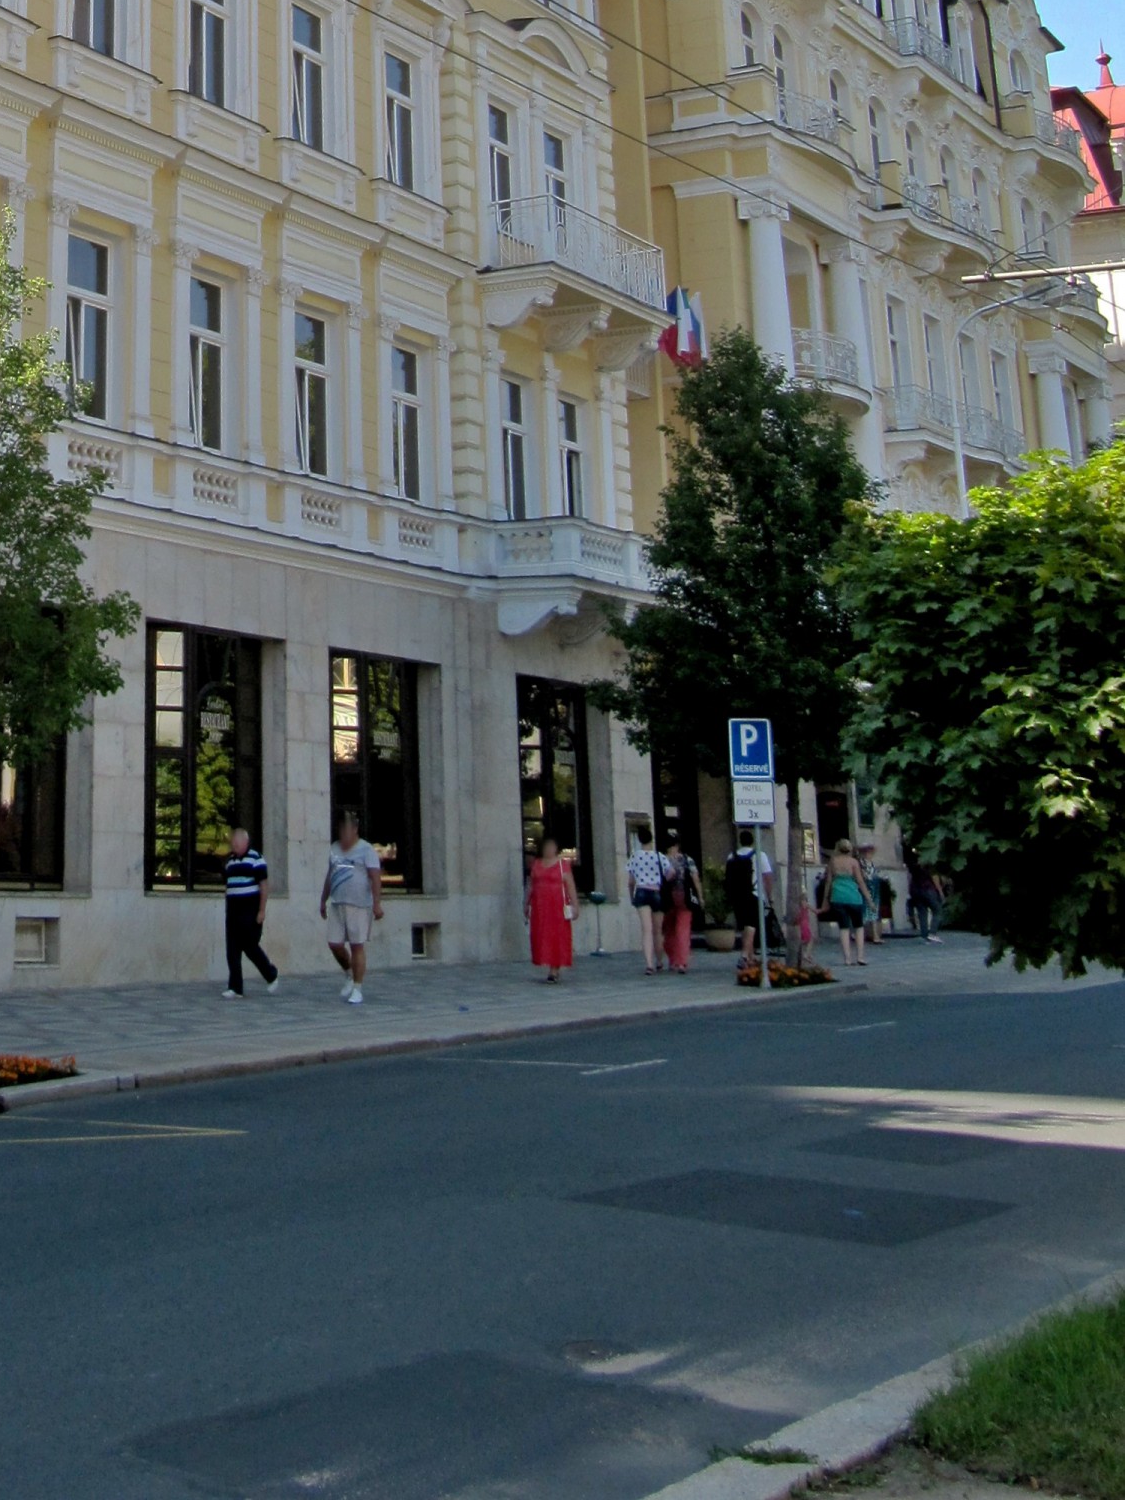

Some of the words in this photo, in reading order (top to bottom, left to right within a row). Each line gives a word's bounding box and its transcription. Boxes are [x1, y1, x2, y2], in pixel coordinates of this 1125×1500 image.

[740, 723, 758, 757] P
[742, 784, 763, 792] HOTEL
[748, 808, 759, 819] 3x
